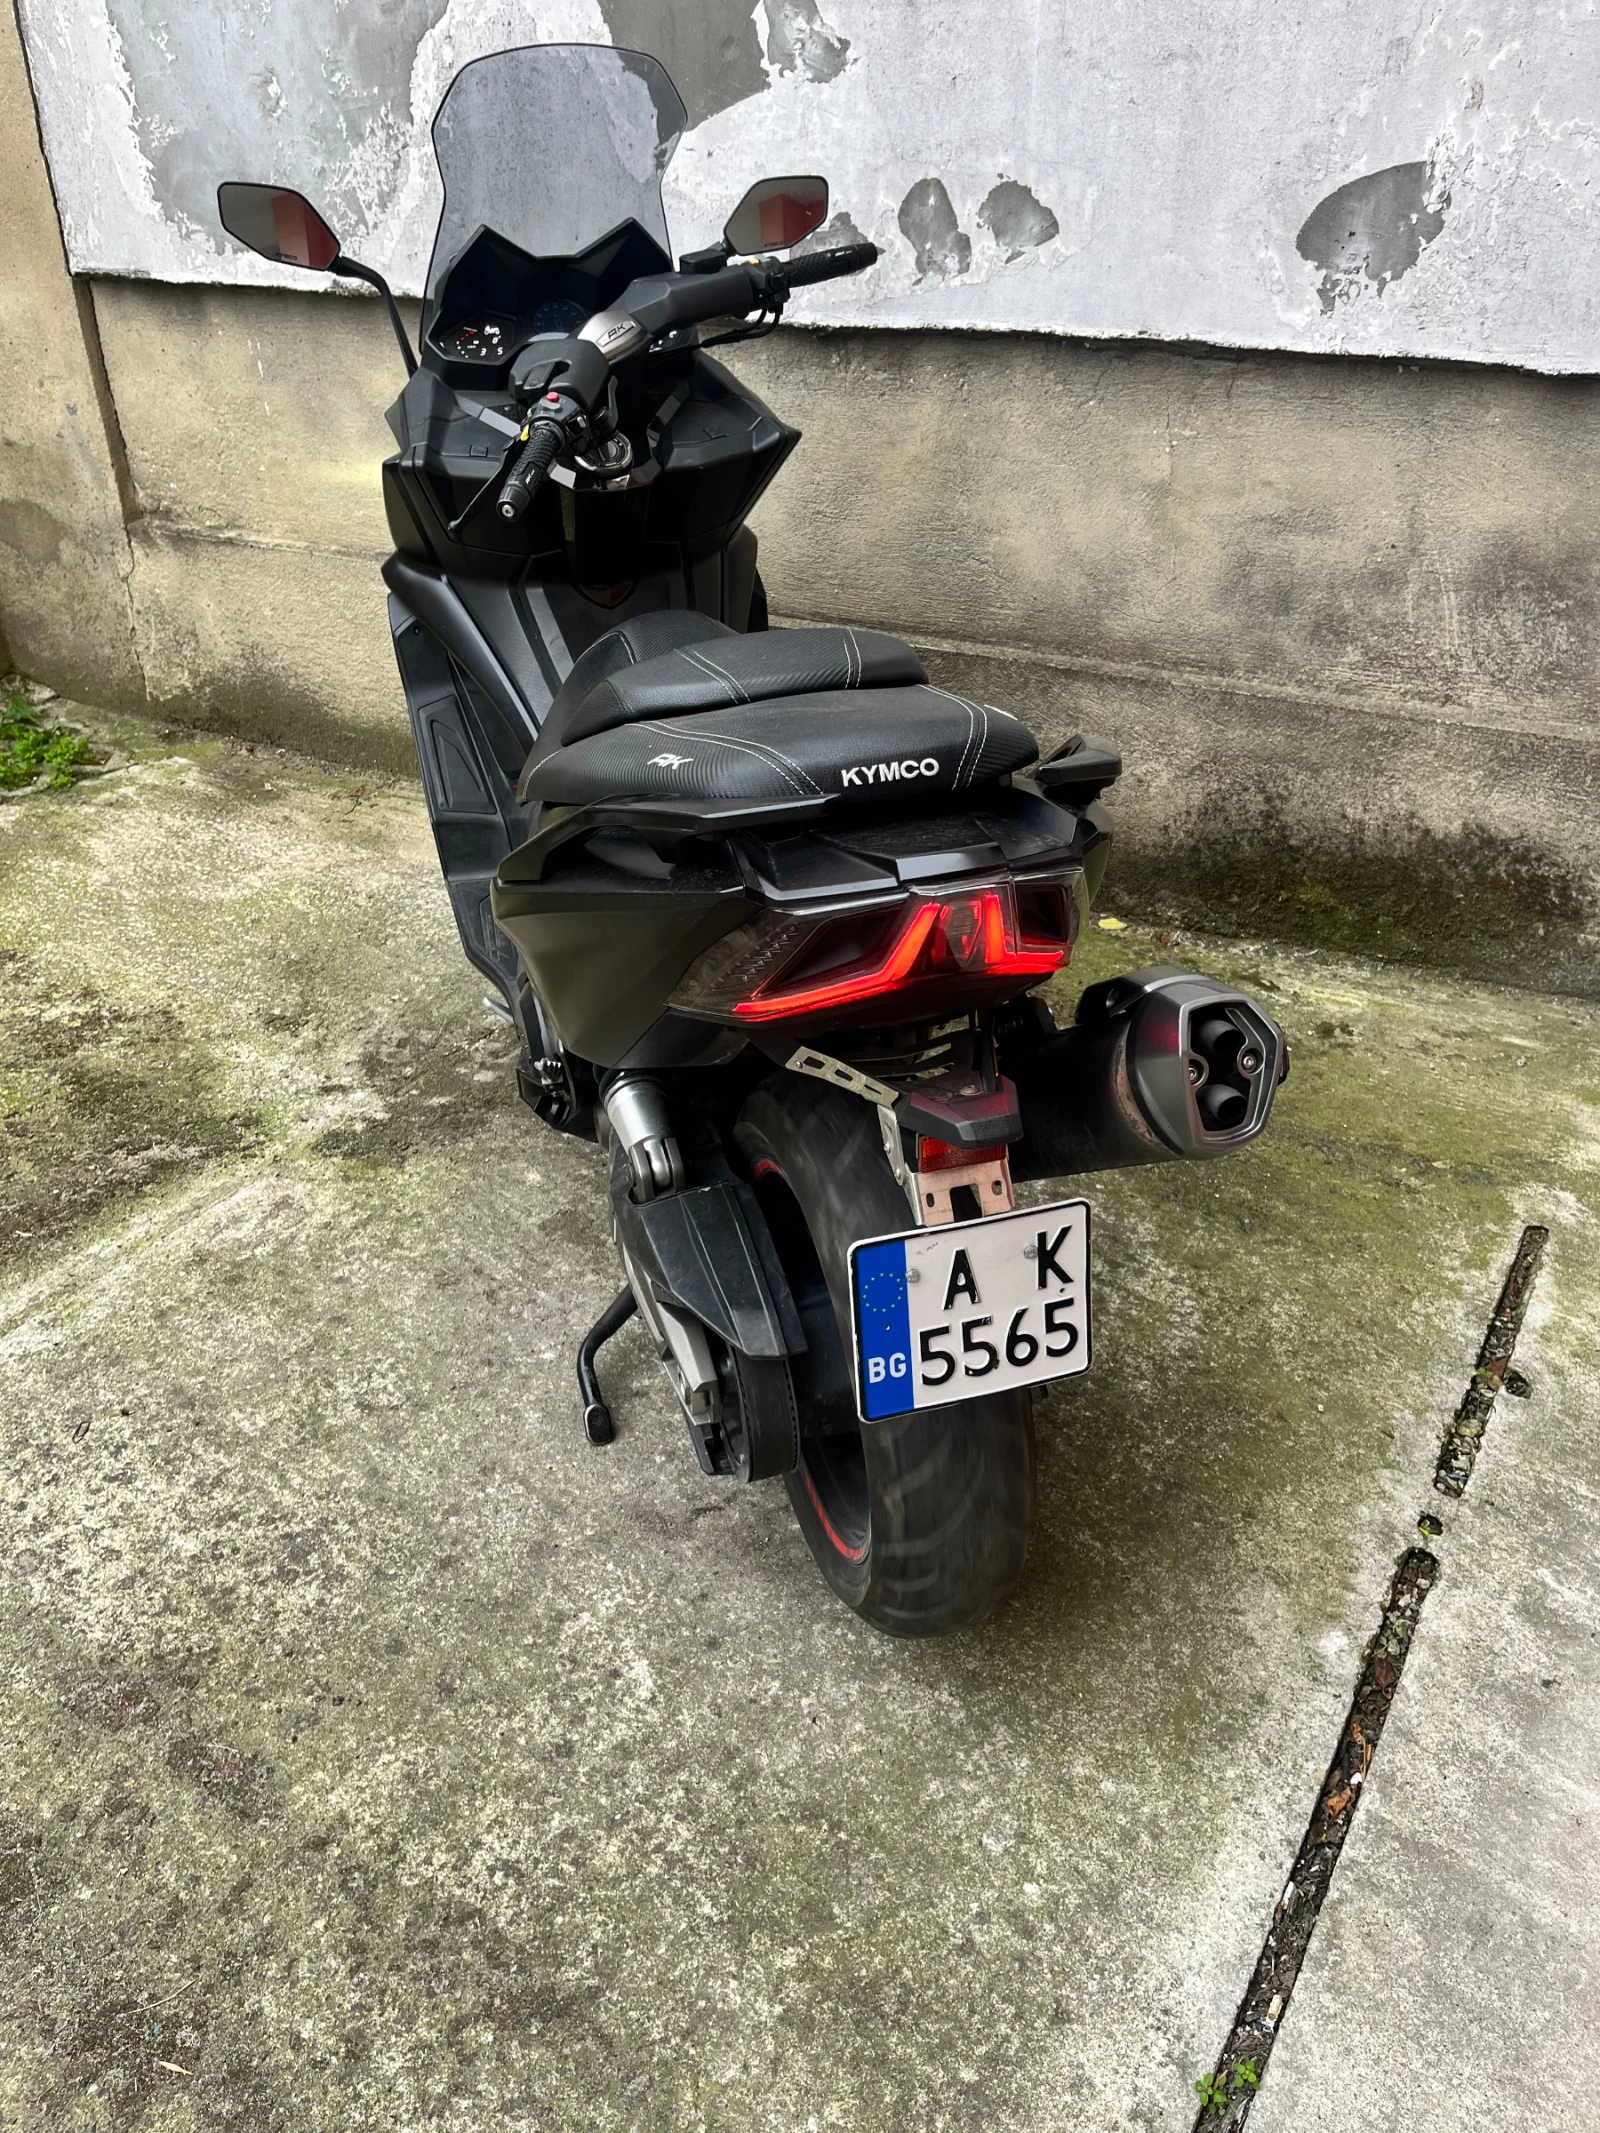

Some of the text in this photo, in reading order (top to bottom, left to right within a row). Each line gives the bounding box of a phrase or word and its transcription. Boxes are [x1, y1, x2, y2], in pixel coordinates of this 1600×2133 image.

[275, 252, 298, 261] KYMCO
[608, 323, 627, 340] AK
[480, 347, 487, 357] 3
[497, 346, 504, 356] 5
[647, 753, 694, 770] AK
[841, 757, 940, 788] KYMCO
[942, 1224, 1074, 1311] A K
[919, 1297, 1079, 1386] 5565
[867, 1352, 907, 1384] BG
